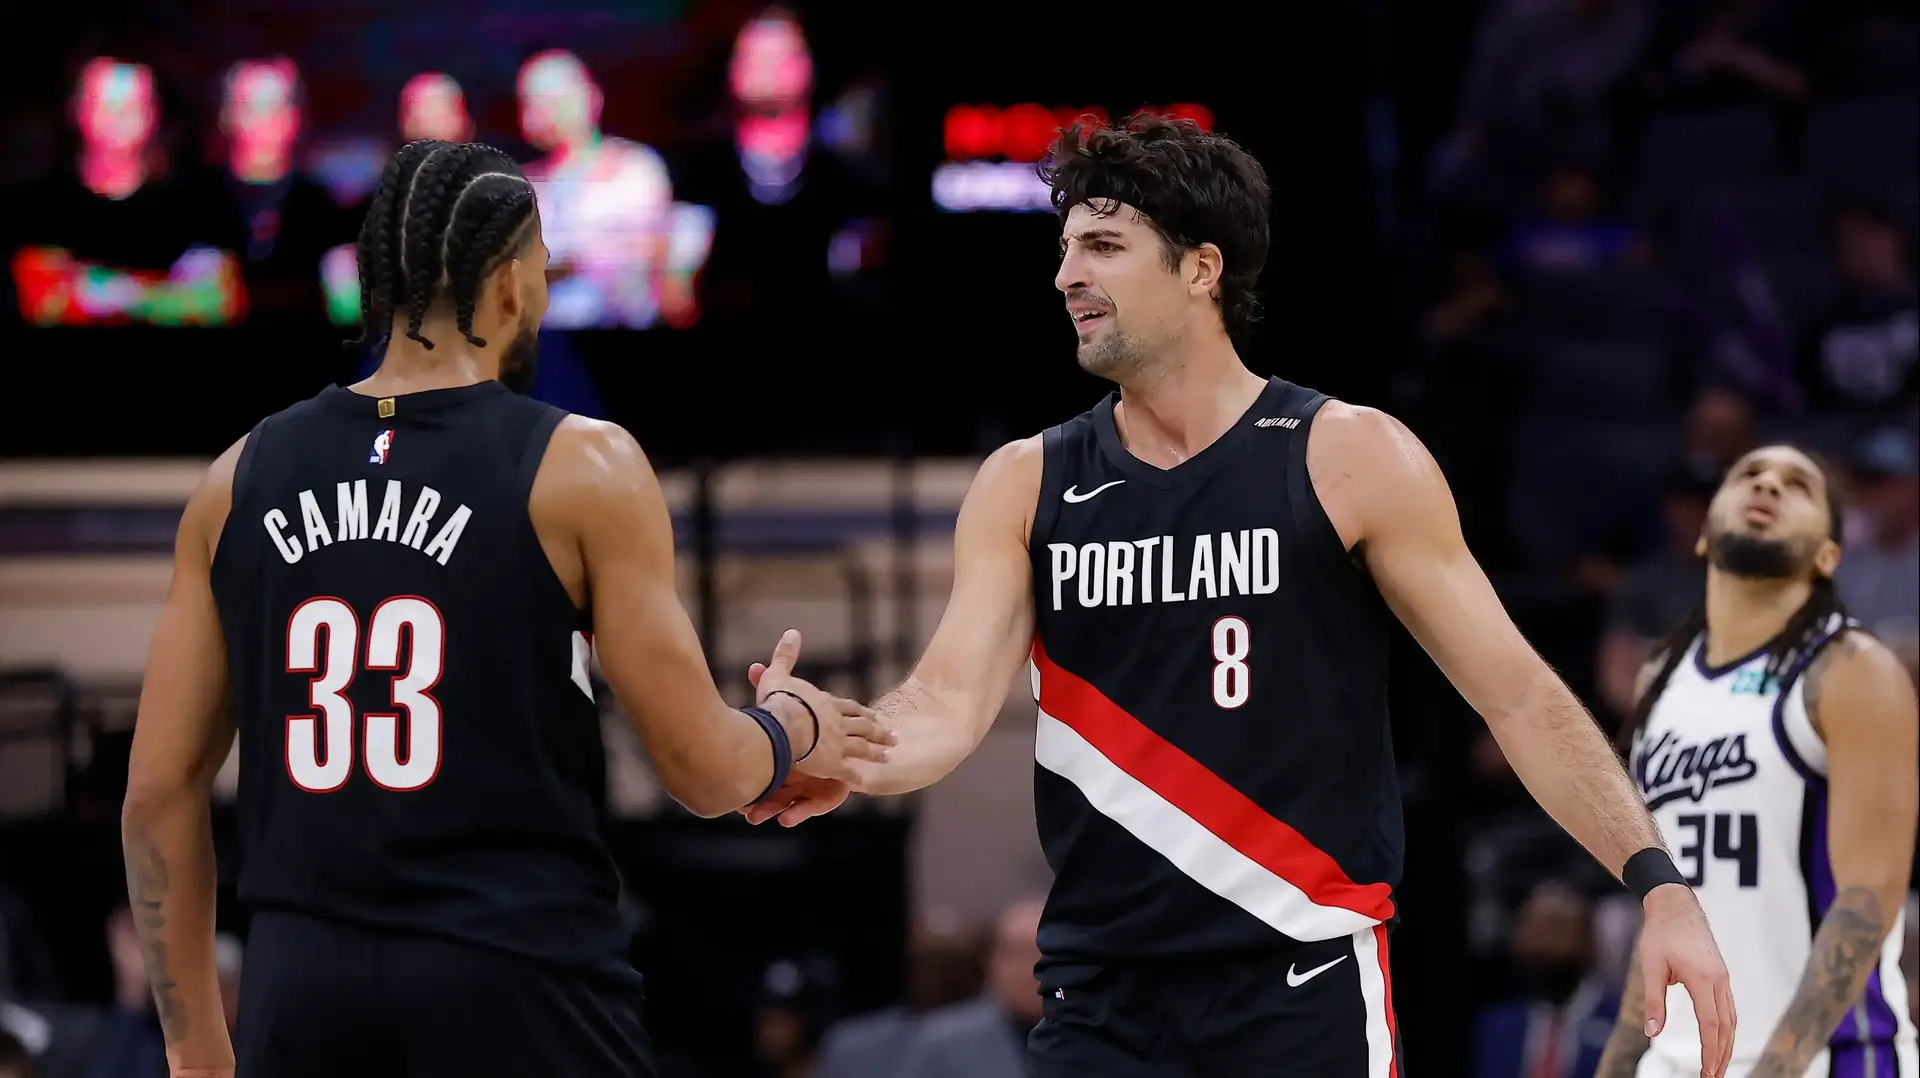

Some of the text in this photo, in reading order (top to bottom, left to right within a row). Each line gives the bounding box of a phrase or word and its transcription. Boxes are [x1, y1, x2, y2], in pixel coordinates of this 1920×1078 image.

[263, 478, 473, 566] CAMARA
[1047, 527, 1280, 611] PORTLAND
[285, 594, 446, 793] 33
[1211, 614, 1251, 710] 8
[1677, 813, 1758, 888] 34
